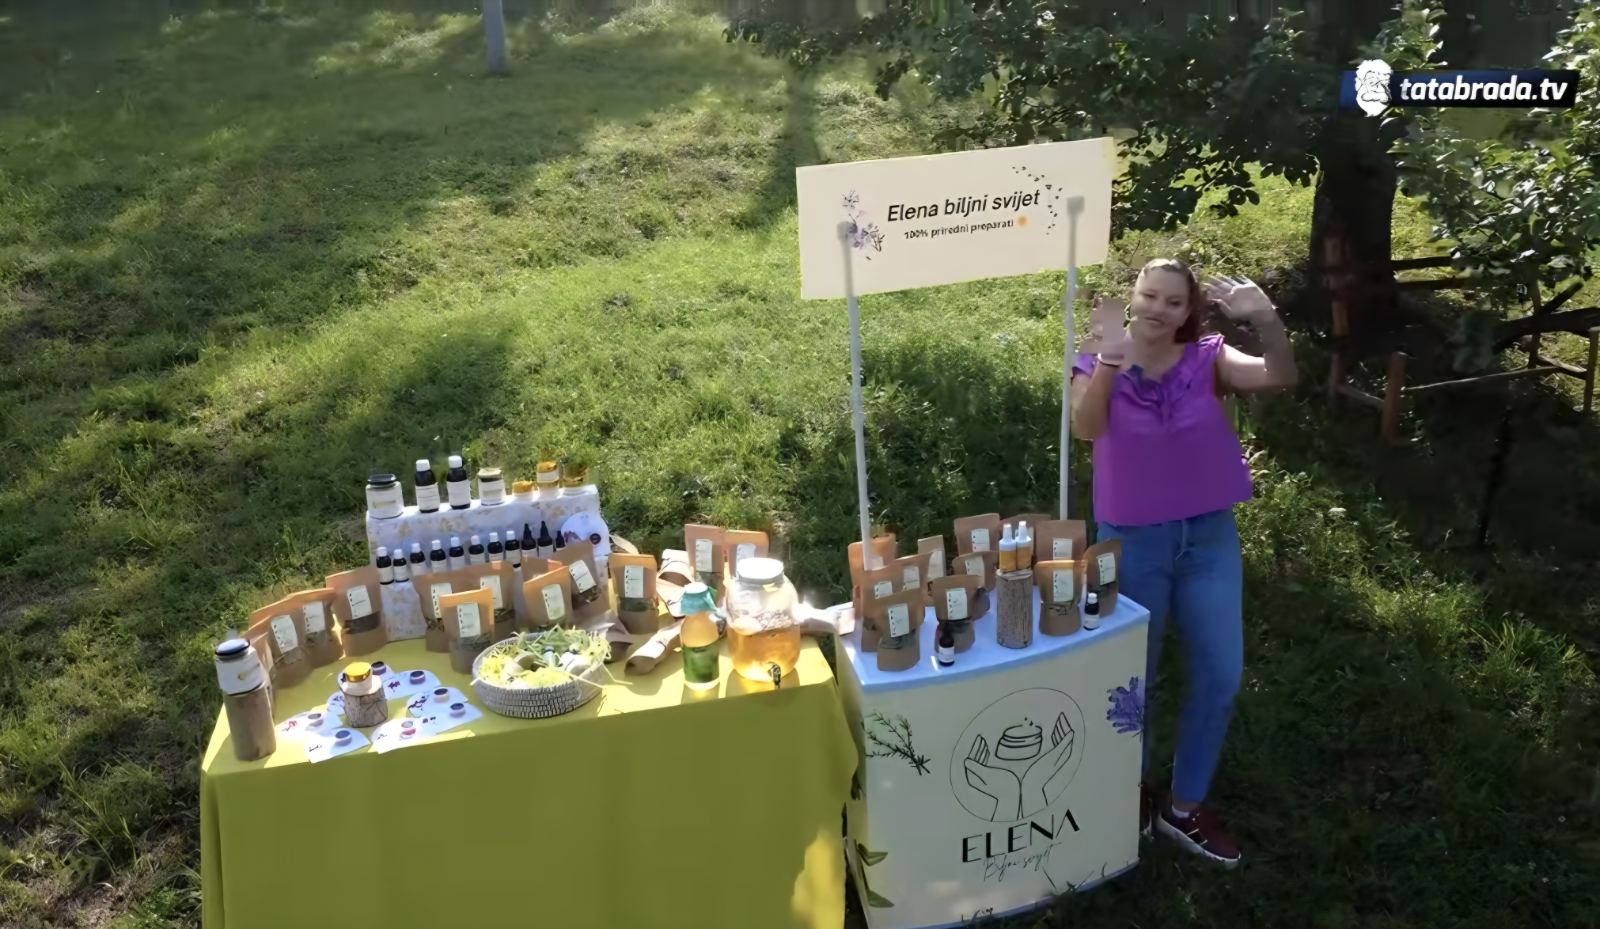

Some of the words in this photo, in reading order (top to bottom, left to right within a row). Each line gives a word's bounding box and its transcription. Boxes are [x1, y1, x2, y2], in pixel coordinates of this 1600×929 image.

[887, 204, 939, 222] Elena
[944, 194, 988, 217] biljni
[991, 189, 1040, 212] svijet
[904, 228, 929, 239] 100%
[962, 808, 1080, 863] ELENA
